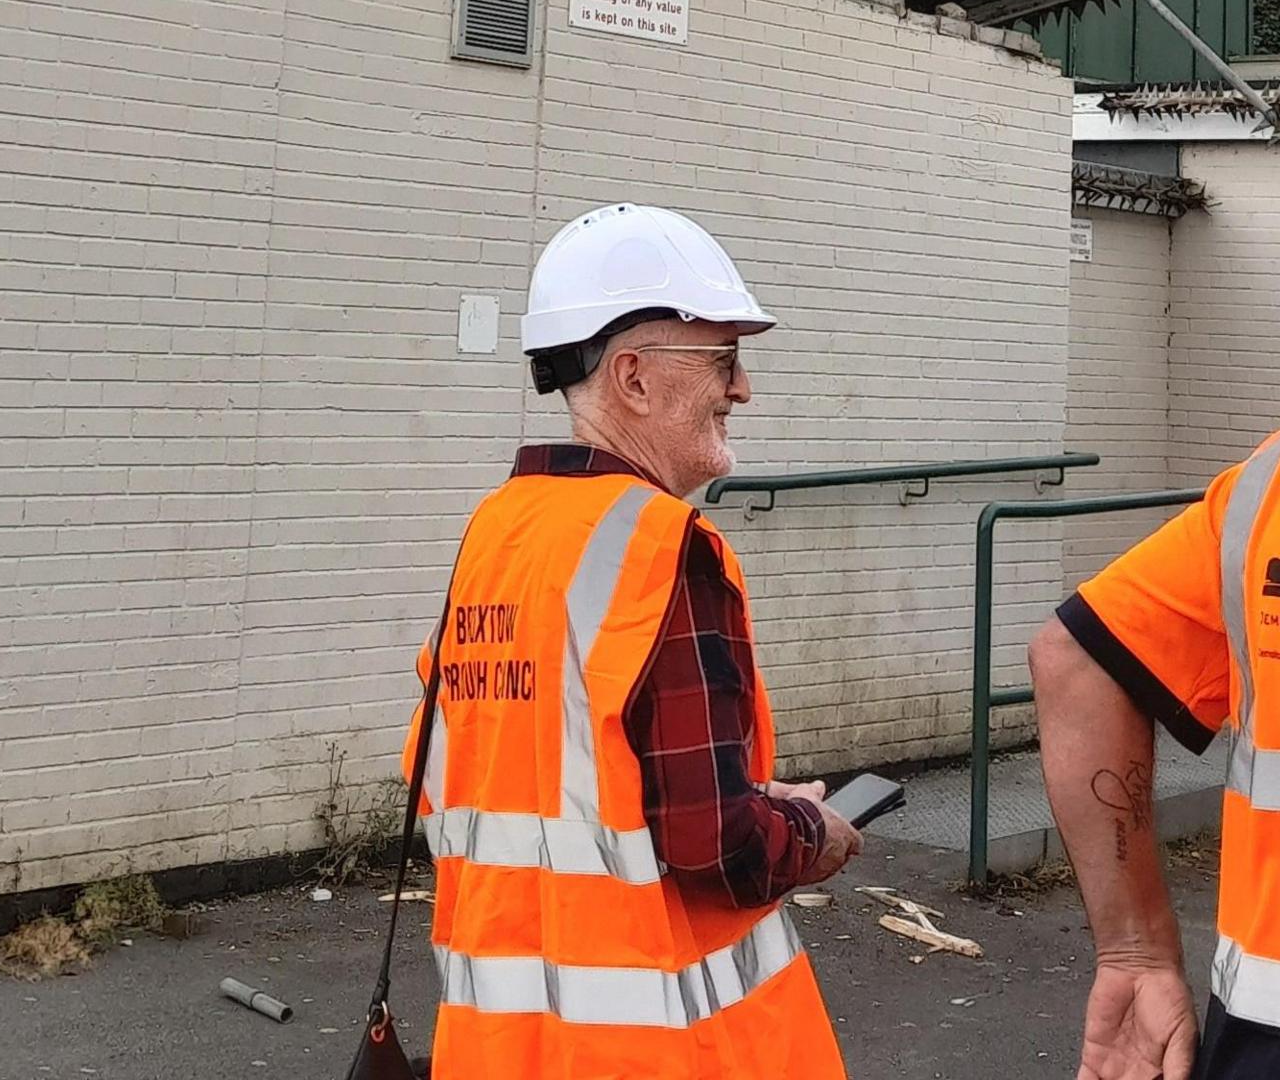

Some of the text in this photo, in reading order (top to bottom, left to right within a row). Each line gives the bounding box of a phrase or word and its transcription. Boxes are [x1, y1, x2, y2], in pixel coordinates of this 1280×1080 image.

[656, 1, 682, 15] value
[581, 7, 677, 35] is kept on this site
